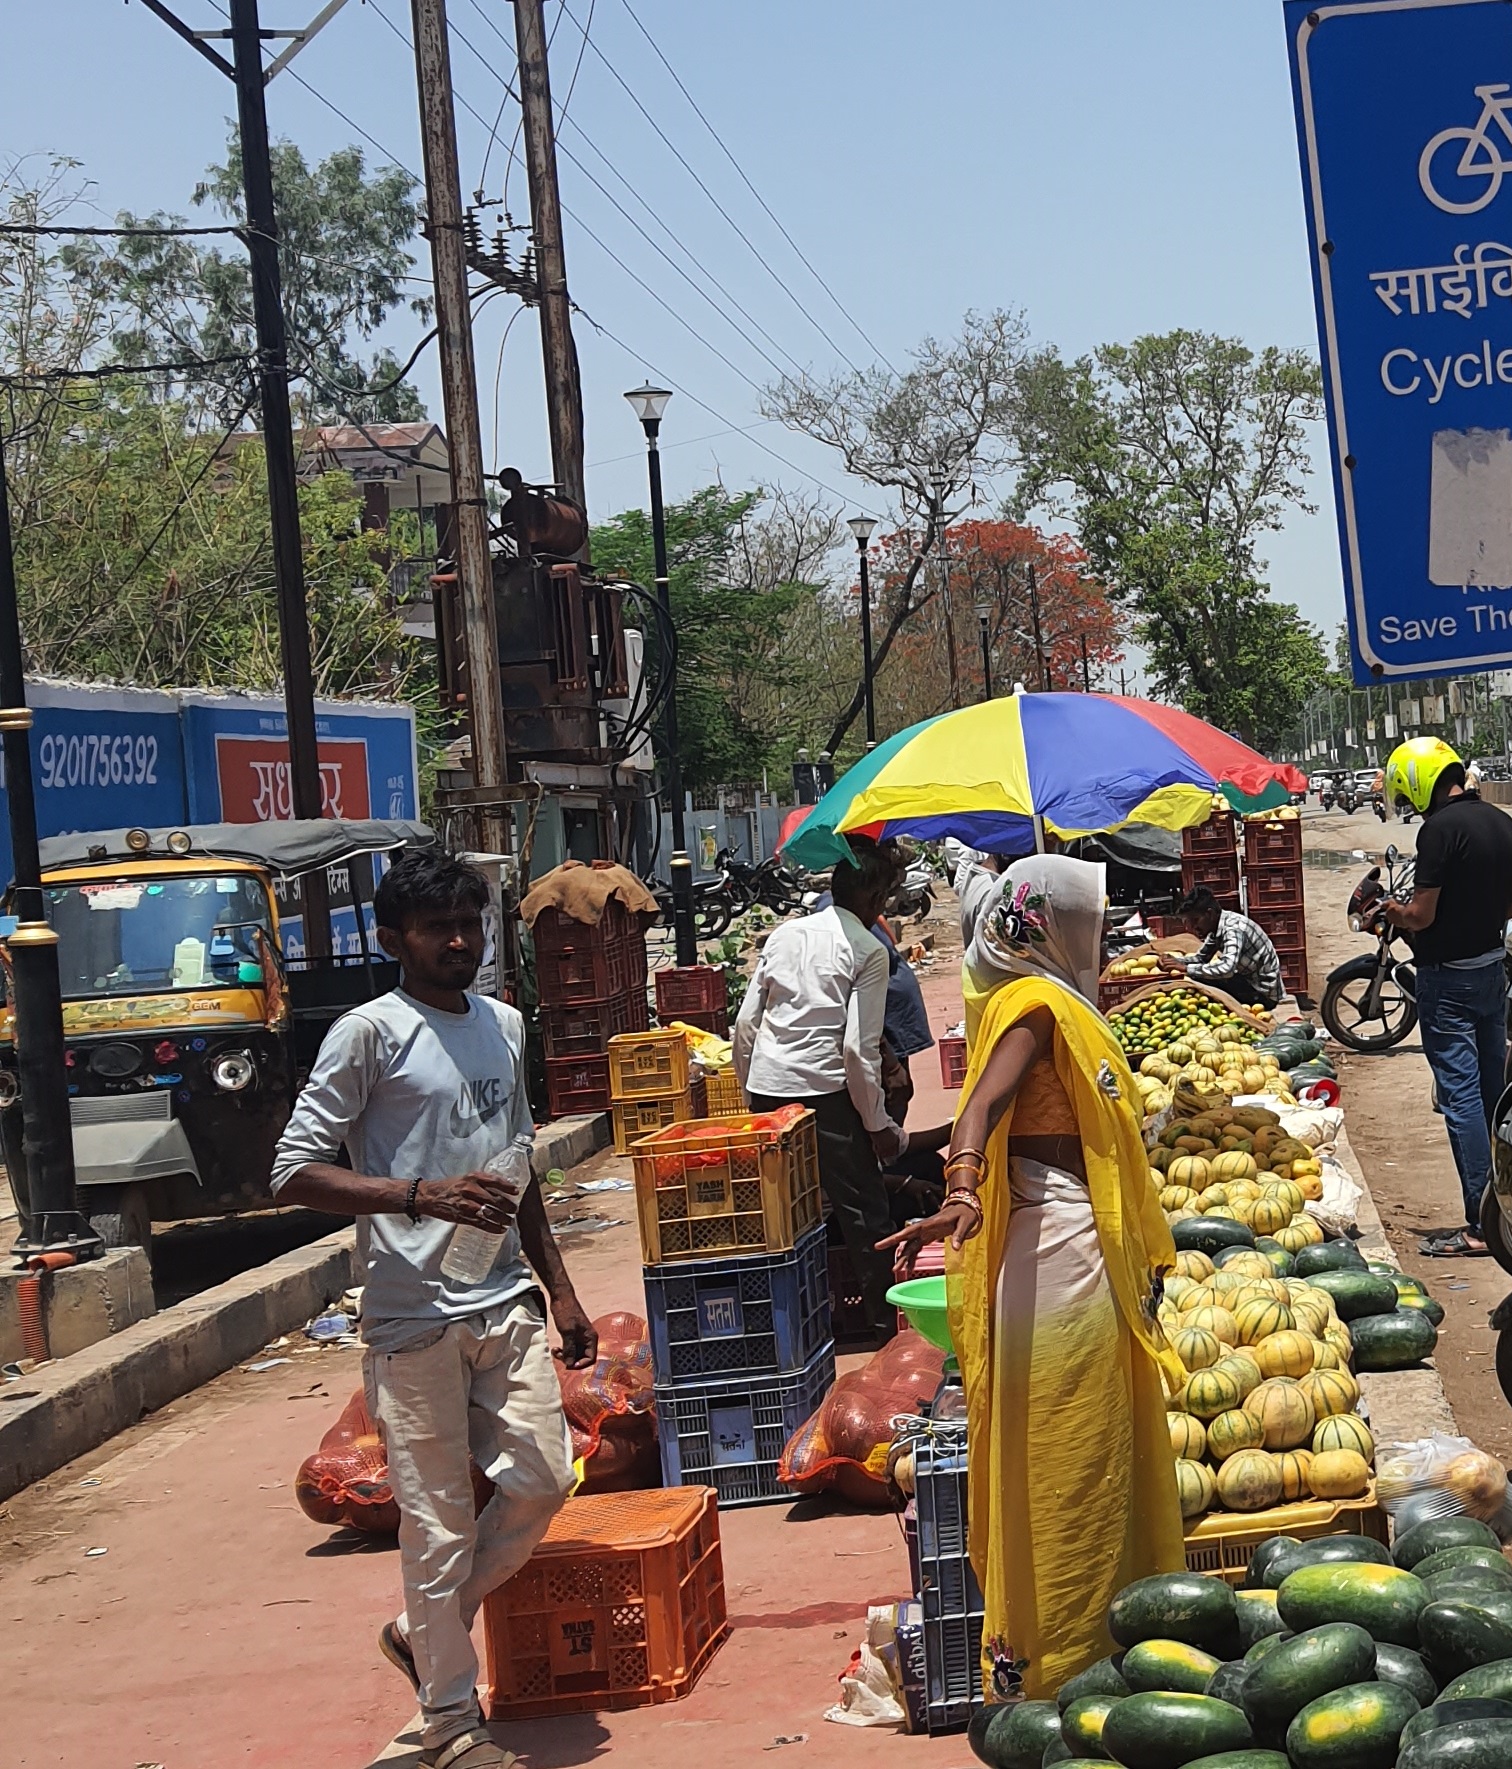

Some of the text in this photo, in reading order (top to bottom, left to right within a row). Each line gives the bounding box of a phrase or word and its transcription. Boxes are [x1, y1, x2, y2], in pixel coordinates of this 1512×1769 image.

[1380, 615, 1457, 644] Save
[40, 734, 158, 788] 9201756392
[191, 1002, 221, 1011] GEM
[459, 1078, 500, 1111] NIKE
[704, 1297, 735, 1332] सतना
